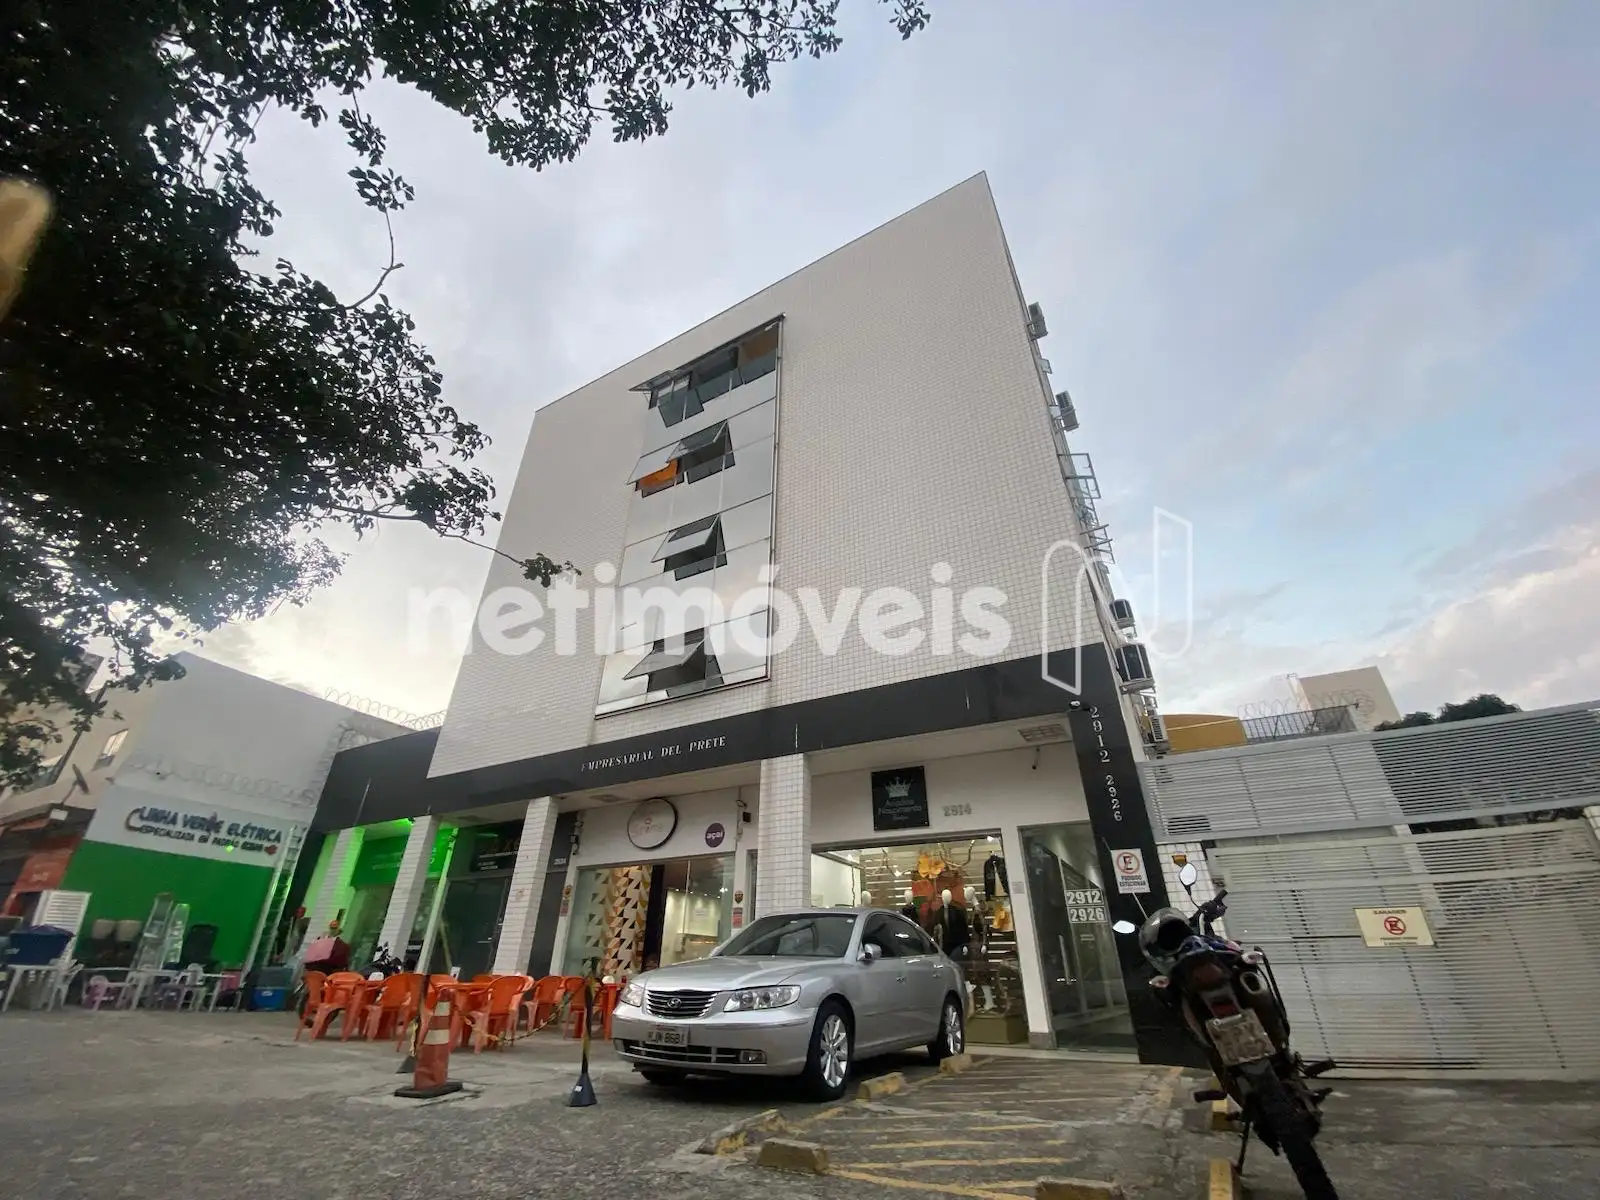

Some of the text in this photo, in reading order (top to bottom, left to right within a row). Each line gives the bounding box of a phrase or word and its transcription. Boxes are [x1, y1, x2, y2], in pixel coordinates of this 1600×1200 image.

[580, 735, 726, 772] EMPRESARIAL DEL PRETE
[1089, 706, 1122, 821] 2912 2926
[1066, 890, 1102, 904] 2912
[1070, 908, 1105, 922] 2926
